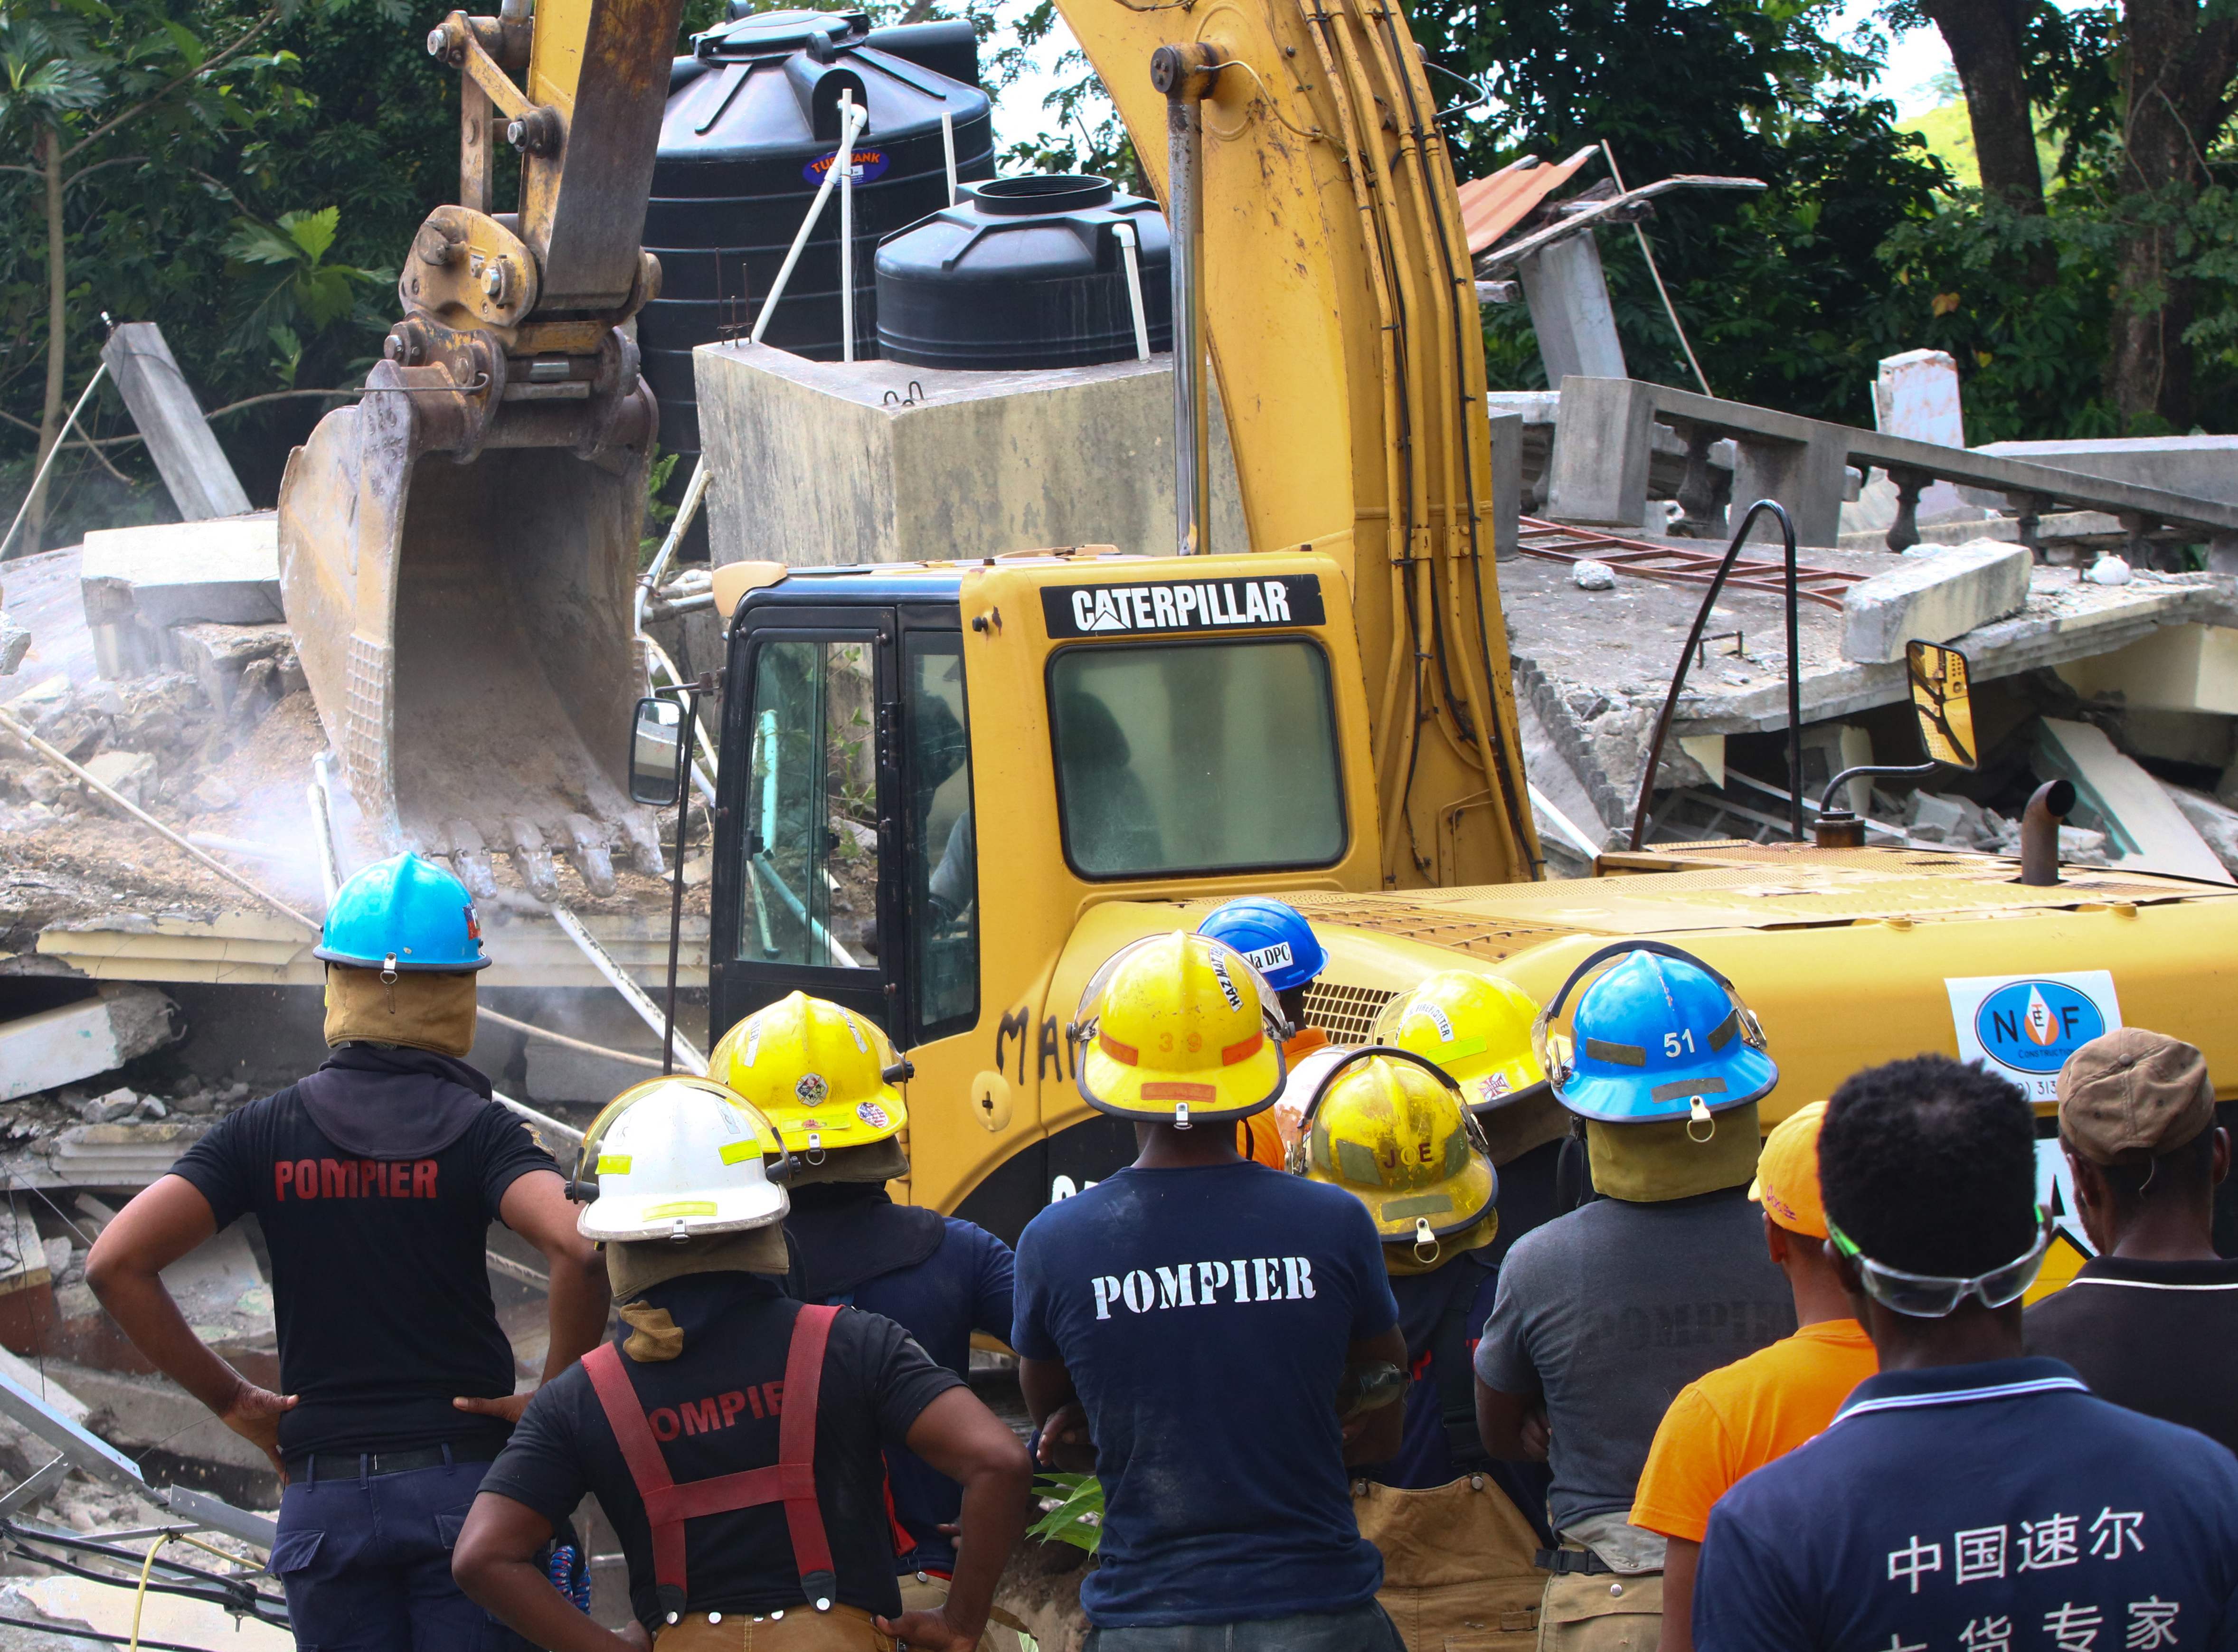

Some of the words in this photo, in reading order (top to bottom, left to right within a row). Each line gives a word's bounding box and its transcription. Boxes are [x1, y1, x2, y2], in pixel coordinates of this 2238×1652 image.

[1071, 581, 1291, 632] CATERPILLAR
[1211, 956, 1229, 978] MAT
[1264, 944, 1290, 966] DPC
[1220, 980, 1240, 1007] HAZ
[1664, 1028, 1695, 1058] 51
[1384, 1142, 1433, 1169] JOE
[274, 1158, 438, 1201] POMPIER
[1091, 1256, 1316, 1320] POMPIER
[649, 1380, 784, 1442] OMPIE
[1887, 1506, 2145, 1595] 中国速尔
